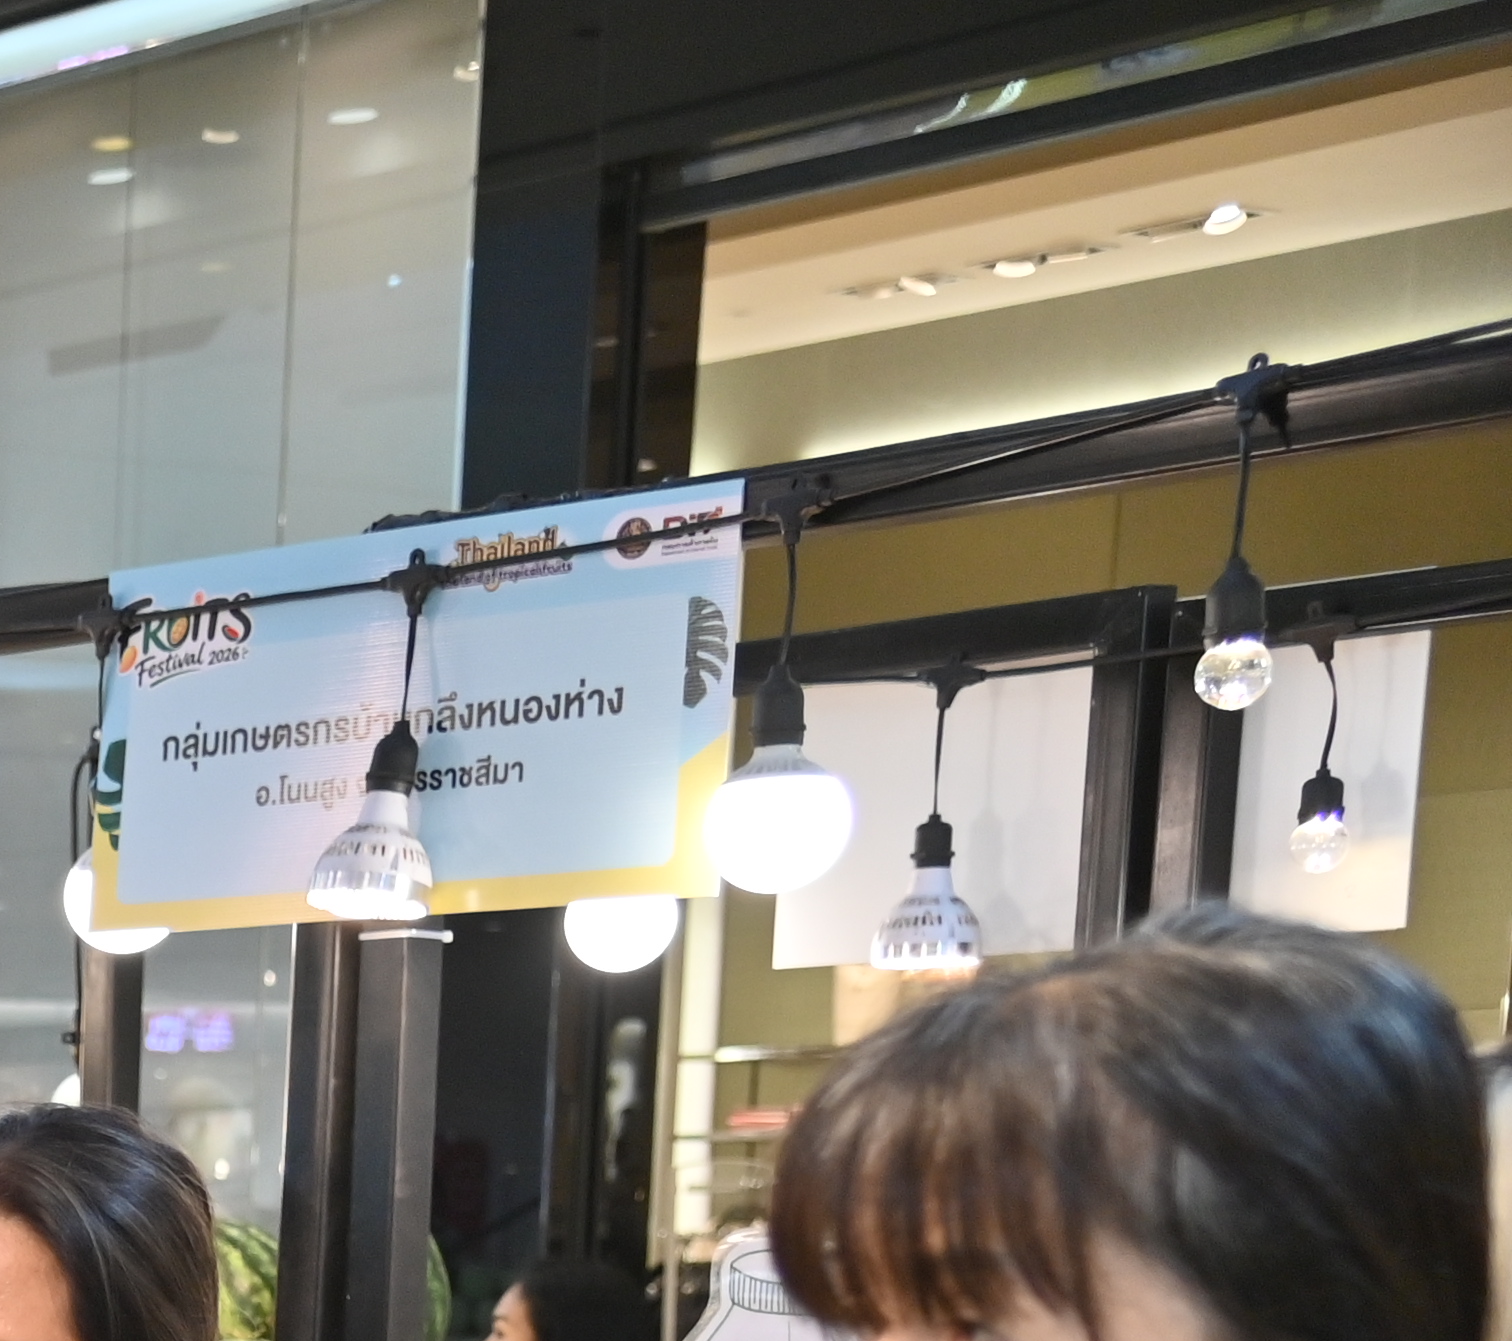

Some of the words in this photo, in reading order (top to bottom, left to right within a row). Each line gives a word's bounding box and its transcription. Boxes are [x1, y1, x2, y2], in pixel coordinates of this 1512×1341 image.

[135, 641, 206, 688] Festival
[208, 647, 240, 666] 2026
[162, 678, 624, 772] กลุ่มเกษตรกรบ้ากลึงหนองห่าง
